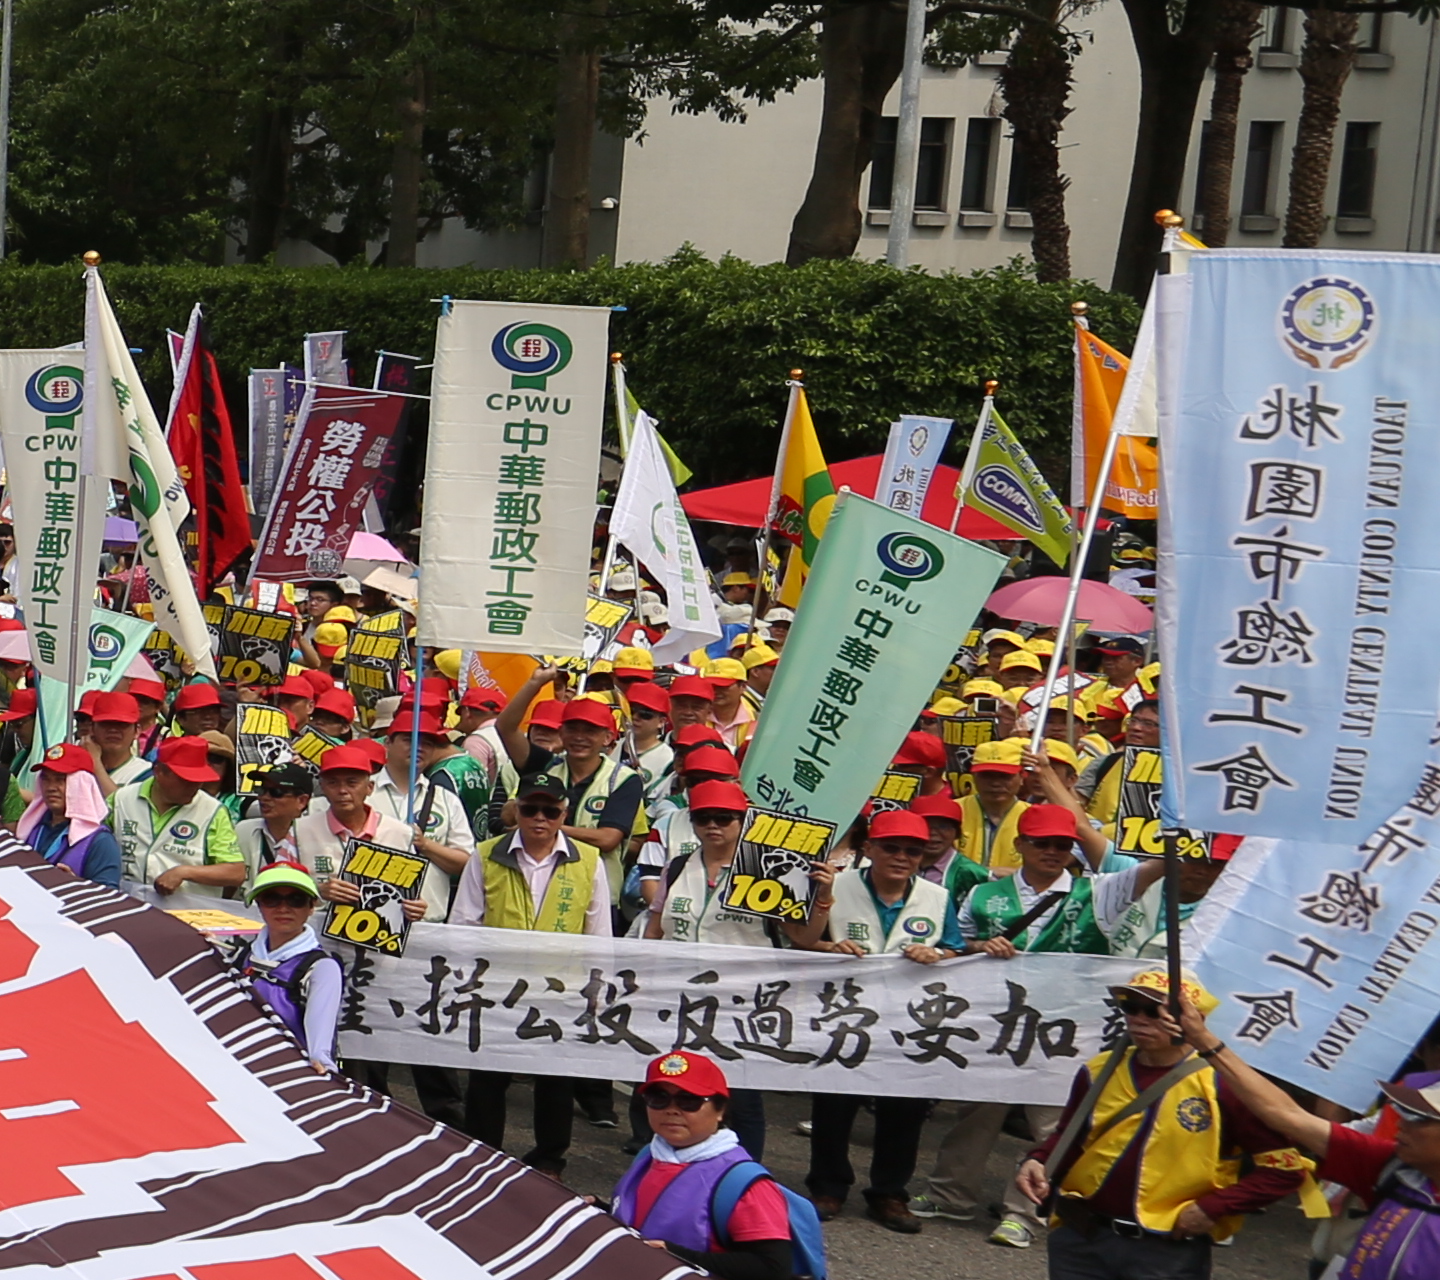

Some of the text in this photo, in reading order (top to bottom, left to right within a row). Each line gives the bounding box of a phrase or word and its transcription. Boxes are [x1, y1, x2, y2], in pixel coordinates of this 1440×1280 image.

[486, 394, 572, 414] CPWU
[25, 435, 81, 451] CPW
[284, 420, 367, 556] 勞權公投
[485, 417, 549, 635] 中華郵政工會
[32, 456, 78, 665] 中華郵政工會
[855, 578, 923, 616] CPWU
[231, 611, 288, 641] 加薪
[220, 656, 282, 685] 10%
[793, 606, 893, 793] 中華郵政工會
[161, 843, 196, 856] CPWU
[744, 812, 831, 855] 加薪
[348, 846, 423, 887] 加薪
[727, 873, 804, 921] 10%
[328, 905, 401, 951] 10%
